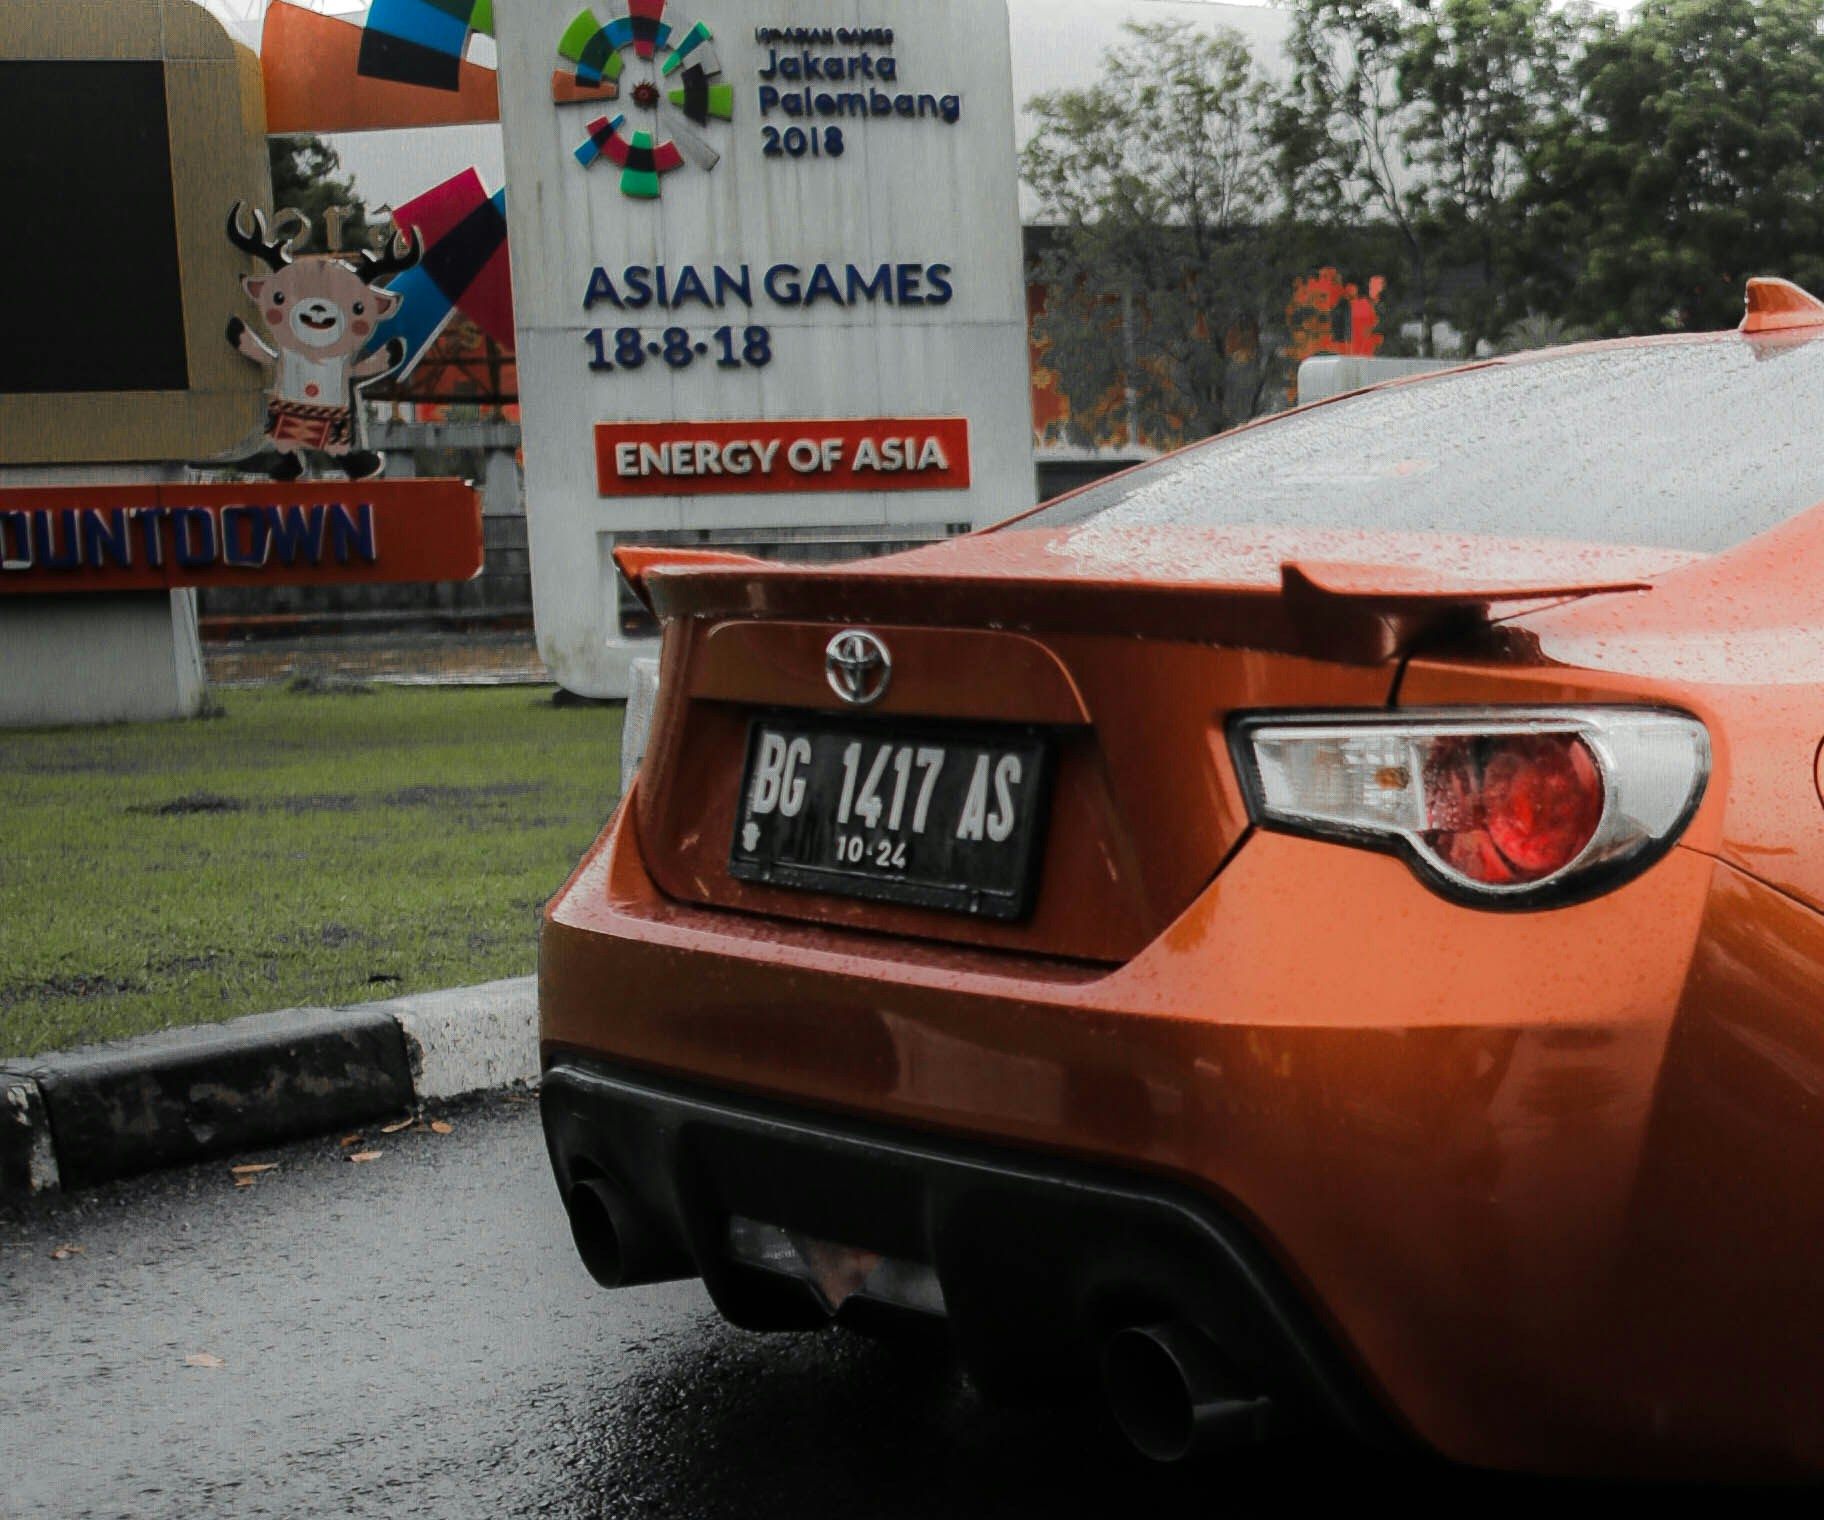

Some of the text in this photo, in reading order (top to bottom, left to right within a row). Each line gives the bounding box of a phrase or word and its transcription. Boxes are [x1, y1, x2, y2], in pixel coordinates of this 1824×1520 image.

[758, 48, 897, 81] Jakarta
[758, 84, 961, 123] Palembang
[761, 125, 845, 158] 2018
[582, 263, 954, 310] ASIAN GAMES
[614, 434, 950, 477] ENERGY OF ASIA
[751, 732, 1023, 842] BG 1417 AS
